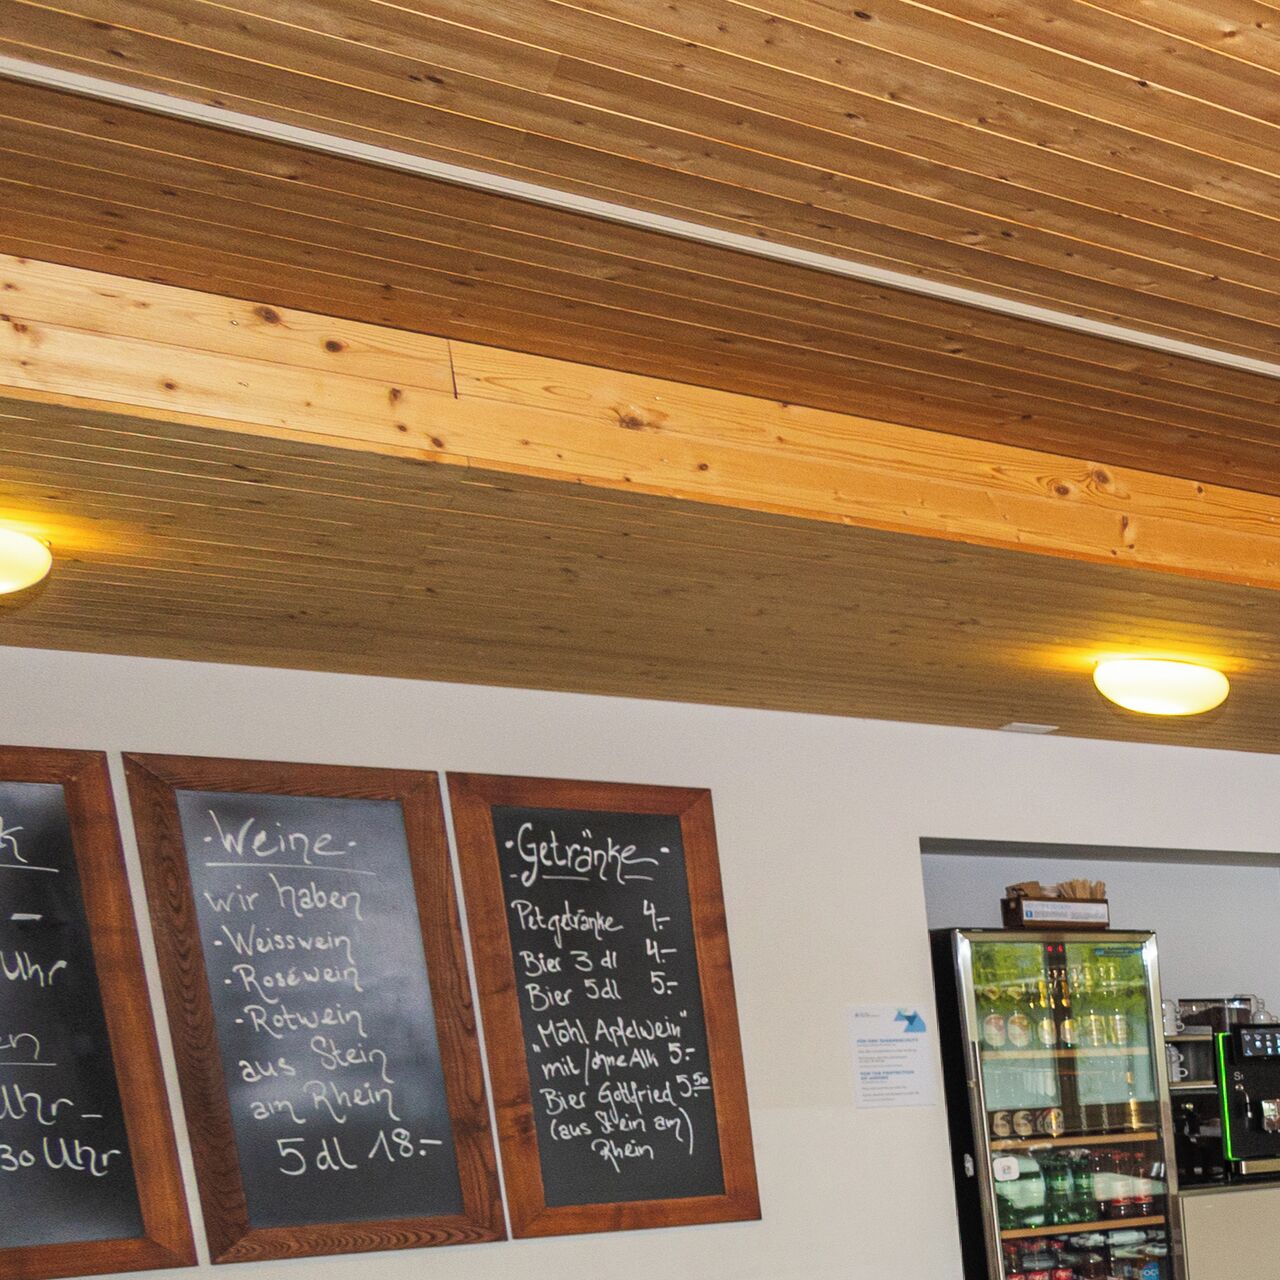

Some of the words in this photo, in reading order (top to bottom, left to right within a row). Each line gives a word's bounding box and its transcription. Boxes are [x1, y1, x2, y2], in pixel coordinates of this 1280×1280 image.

[204, 884, 259, 913] wir
[269, 872, 364, 921] haben
[519, 950, 563, 977] Bier
[570, 951, 593, 972] 3
[600, 949, 618, 969] dl
[525, 983, 573, 1011] Bier
[238, 1056, 297, 1083] aus
[310, 1035, 395, 1085] Stein
[250, 1099, 306, 1125] am
[303, 1080, 401, 1125] Rhein
[539, 1088, 587, 1115] Bier
[598, 1080, 678, 1125] Gottfried
[595, 1109, 647, 1134] Stein
[43, 1137, 121, 1177] Uhr
[590, 1138, 655, 1173] Rhein
